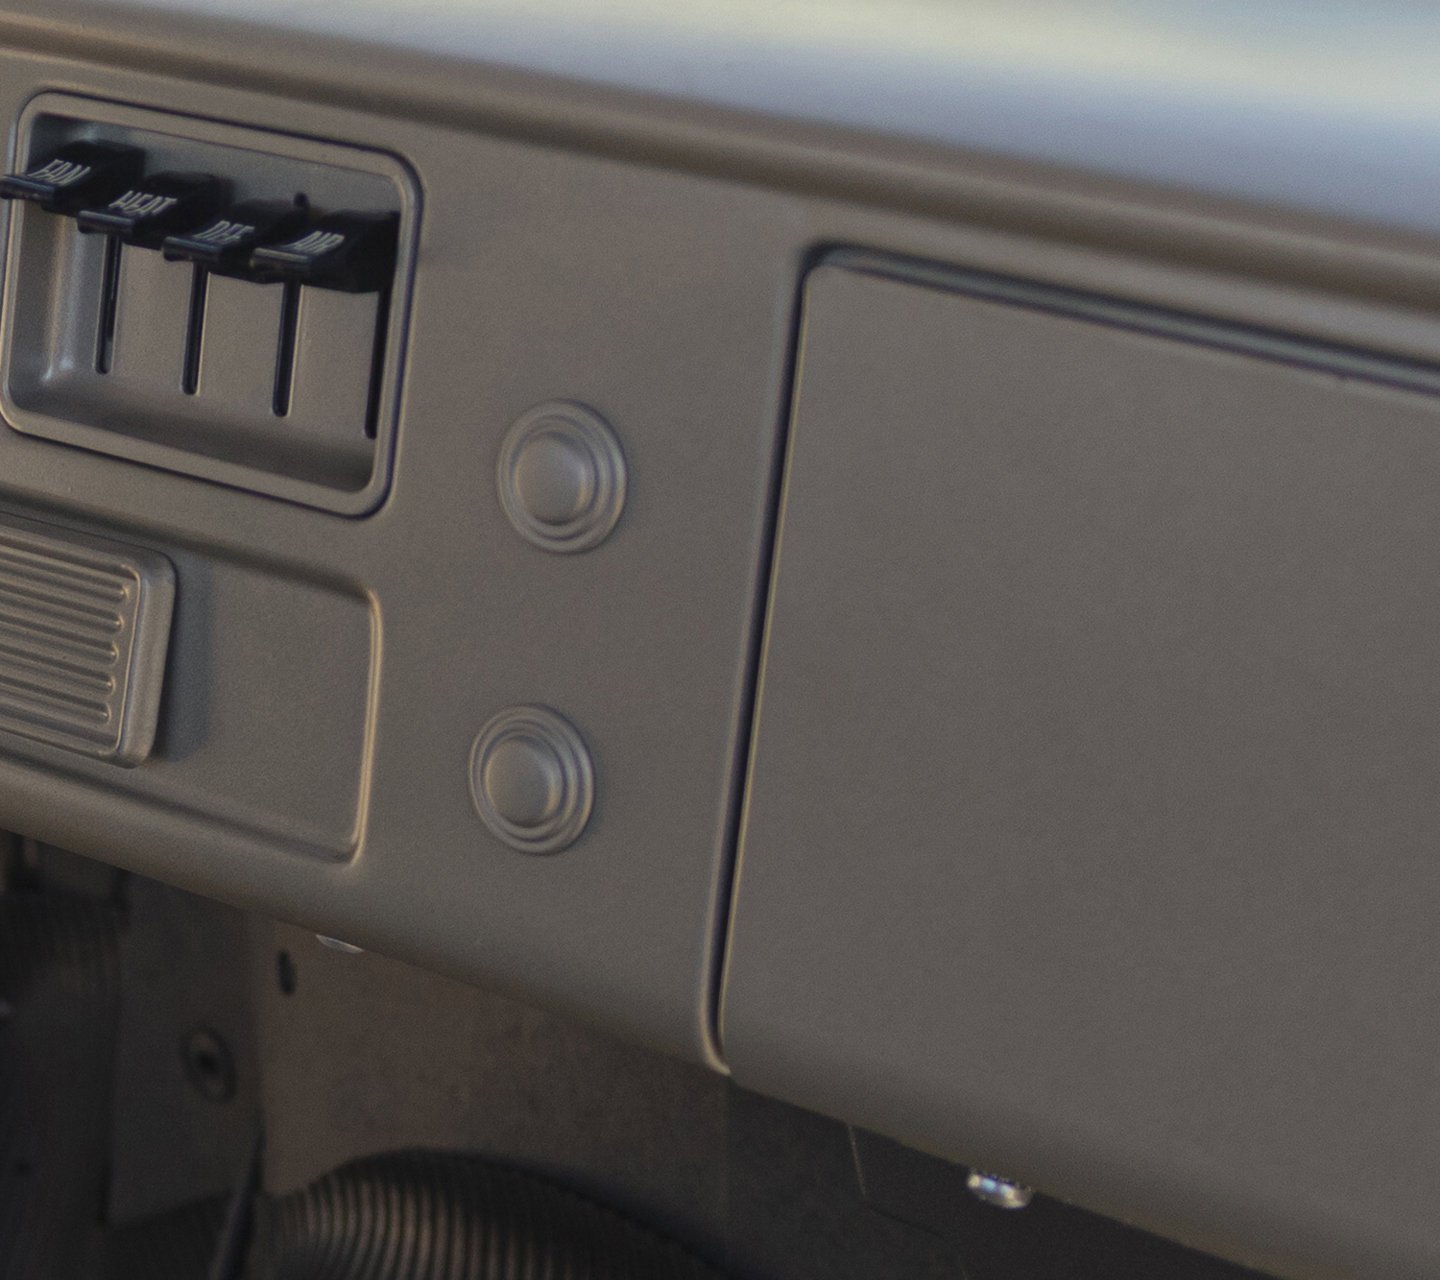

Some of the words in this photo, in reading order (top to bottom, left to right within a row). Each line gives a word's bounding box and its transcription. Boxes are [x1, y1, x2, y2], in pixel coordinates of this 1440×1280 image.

[28, 159, 91, 186] FAN
[108, 190, 178, 217] HEAT
[193, 219, 255, 246] DEF
[286, 230, 345, 255] AIR
